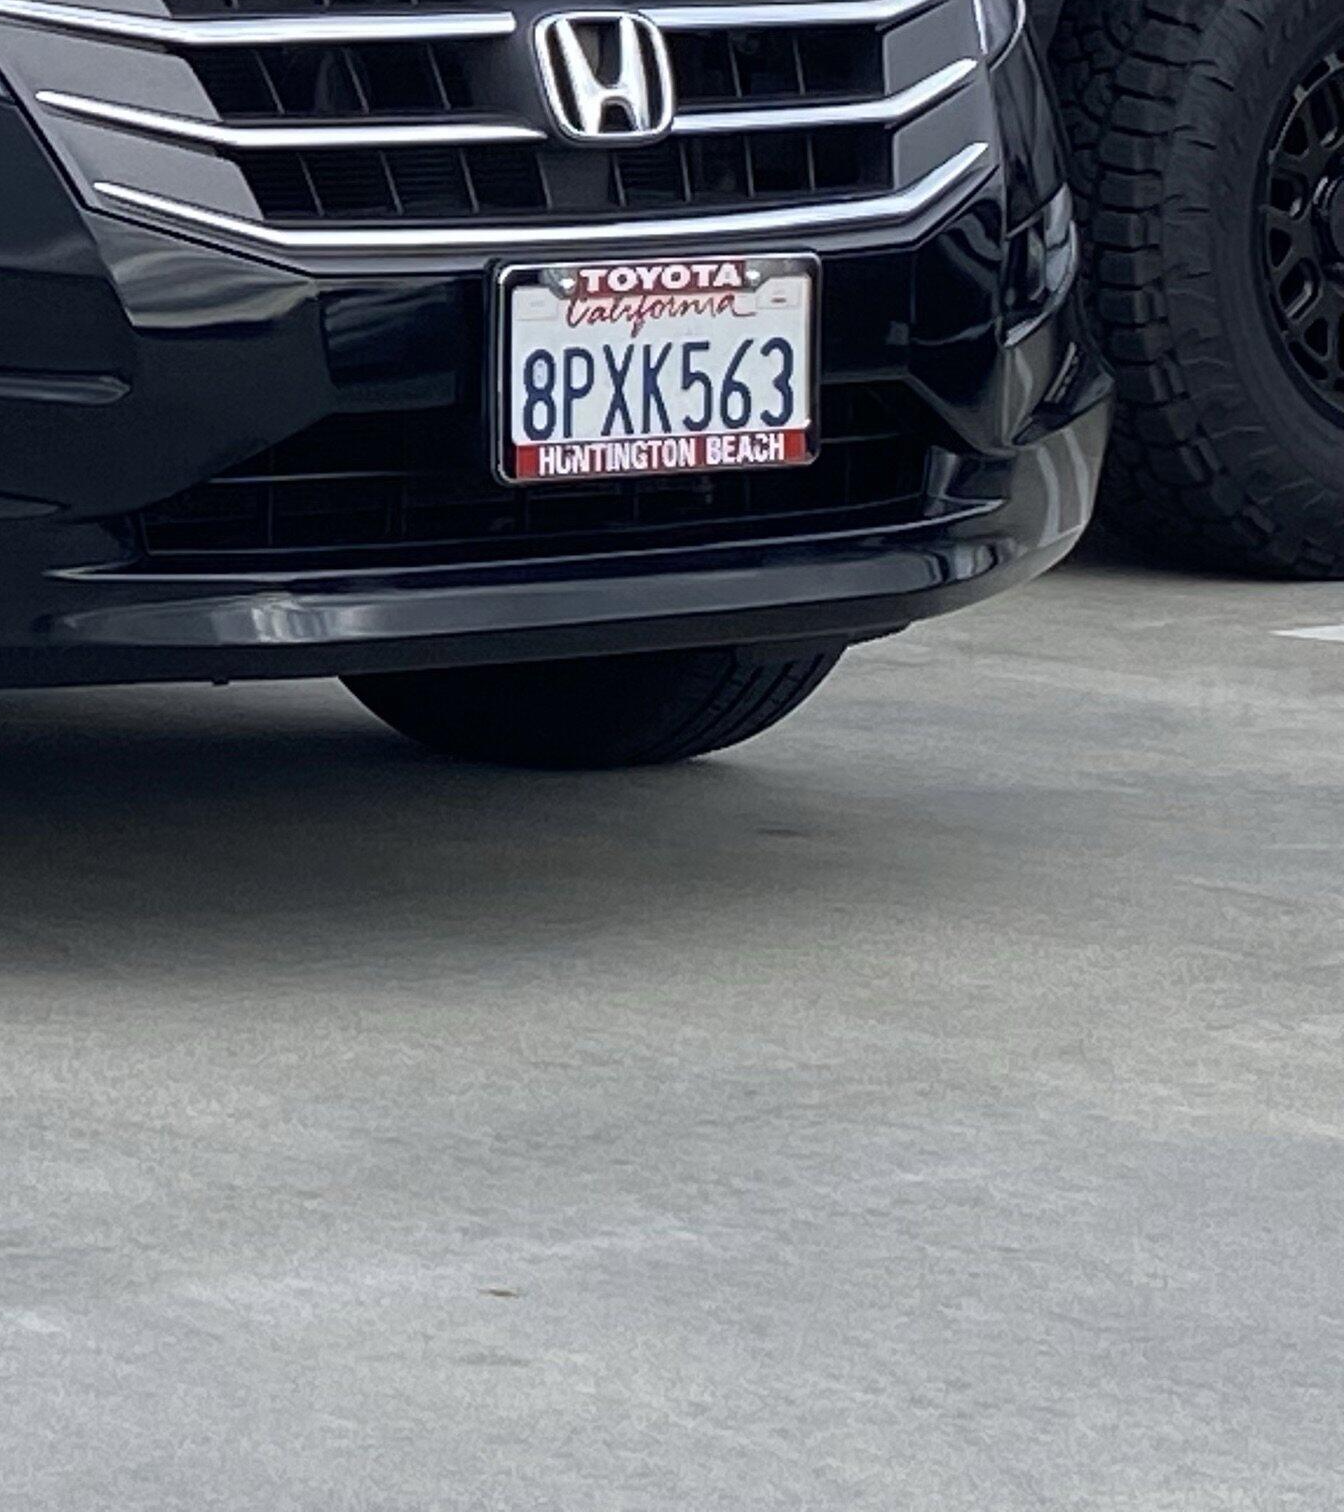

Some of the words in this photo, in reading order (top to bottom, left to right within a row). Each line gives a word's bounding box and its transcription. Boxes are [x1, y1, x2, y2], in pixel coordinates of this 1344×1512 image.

[578, 263, 743, 293] TOYOTA
[566, 293, 757, 338] California
[523, 338, 794, 441] 8PXK563
[539, 437, 696, 476] HUNTINGTON
[706, 433, 785, 465] BEACH
